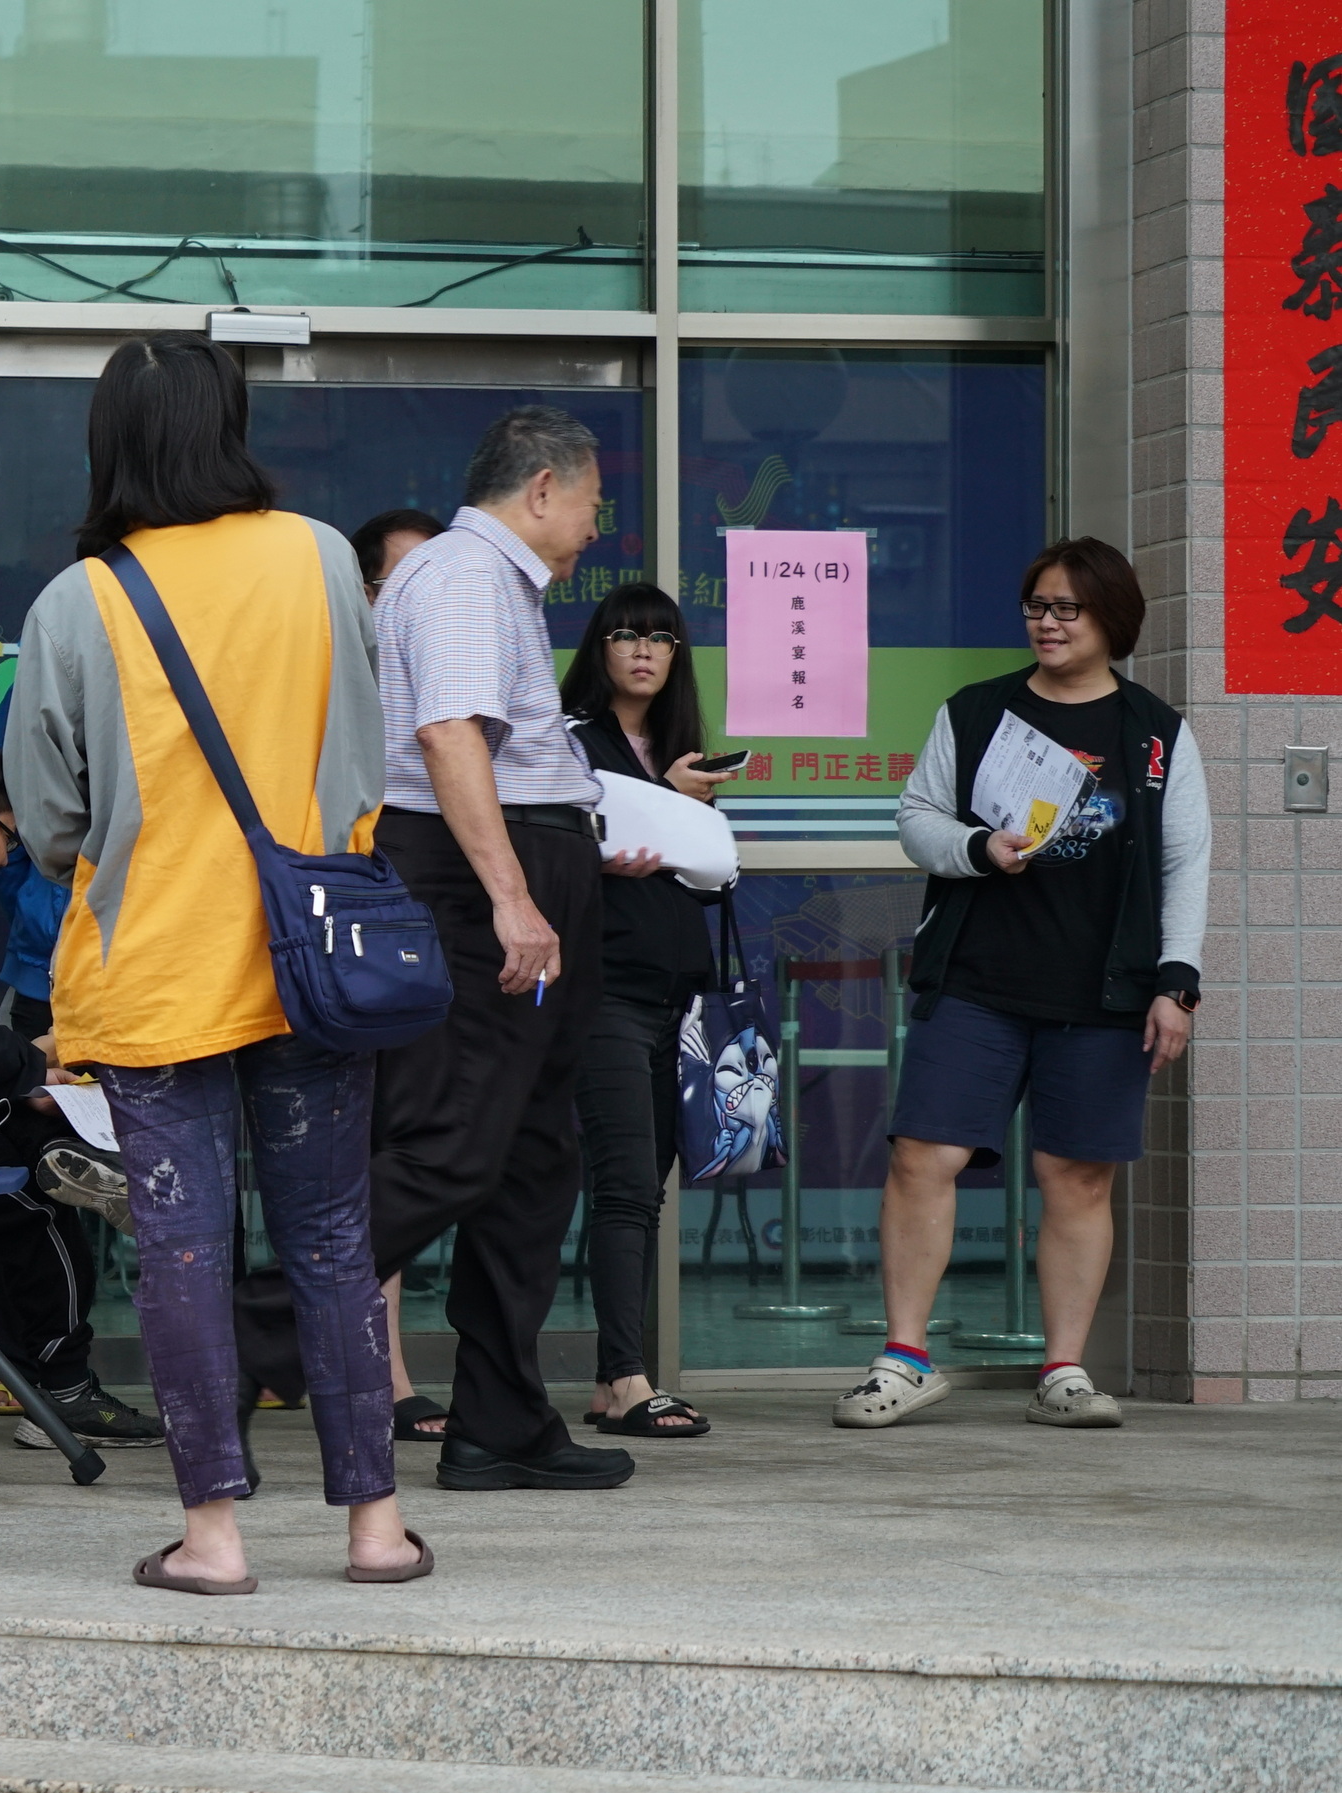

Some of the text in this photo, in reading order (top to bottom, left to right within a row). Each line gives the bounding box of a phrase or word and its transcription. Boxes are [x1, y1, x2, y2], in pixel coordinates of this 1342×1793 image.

[750, 561, 850, 583] 11/24 (日)
[790, 595, 807, 710] 鹿溪宴報名
[649, 1397, 673, 1408] NIKE
